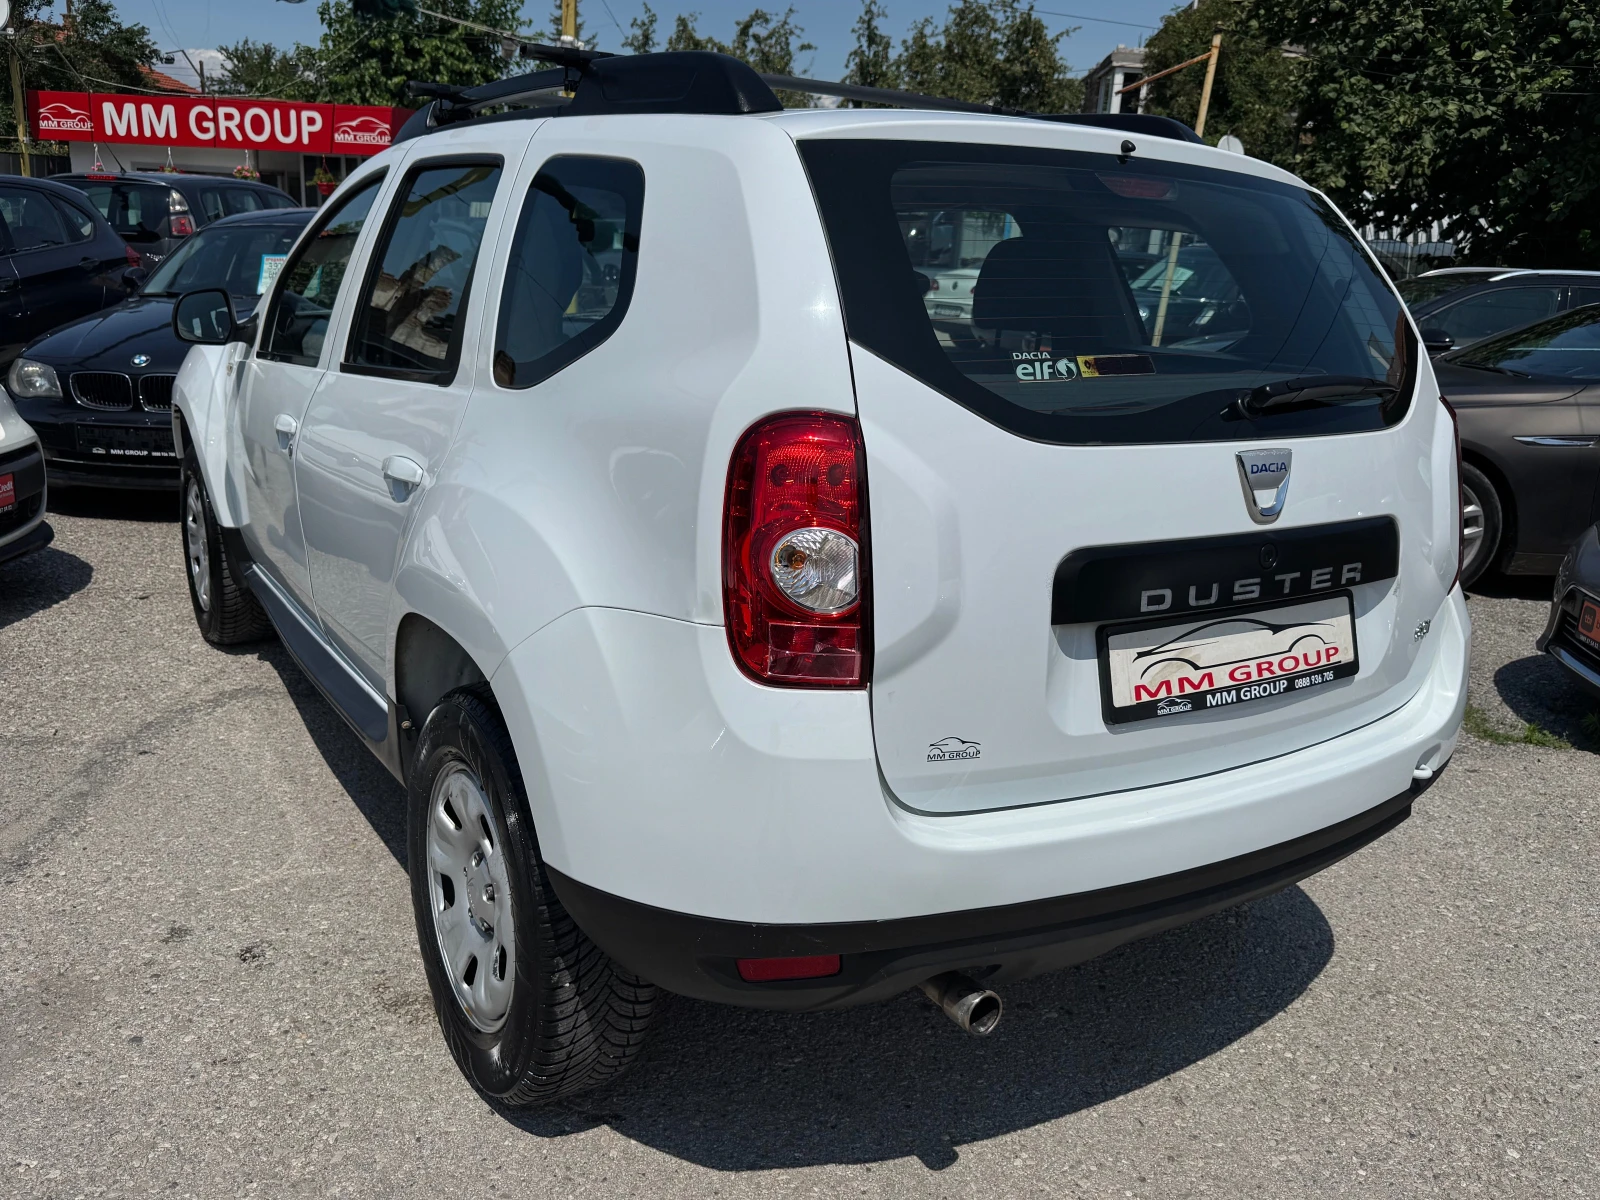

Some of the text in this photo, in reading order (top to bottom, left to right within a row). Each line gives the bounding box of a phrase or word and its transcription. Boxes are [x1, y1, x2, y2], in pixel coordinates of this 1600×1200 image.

[39, 120, 94, 129] MM GROUP
[102, 101, 323, 145] MM GROUP
[334, 133, 391, 143] MM GROUP
[1012, 351, 1050, 360] DACIA
[1015, 361, 1053, 380] elf
[1250, 461, 1287, 475] DACIA
[1140, 562, 1362, 613] DUSTER
[1134, 646, 1340, 702] MM GROUP
[1206, 690, 1237, 707] MM
[1240, 680, 1288, 701] GROUP
[1294, 676, 1311, 689] 0888
[1170, 704, 1192, 713] GROUP
[948, 750, 981, 759] GROUP
